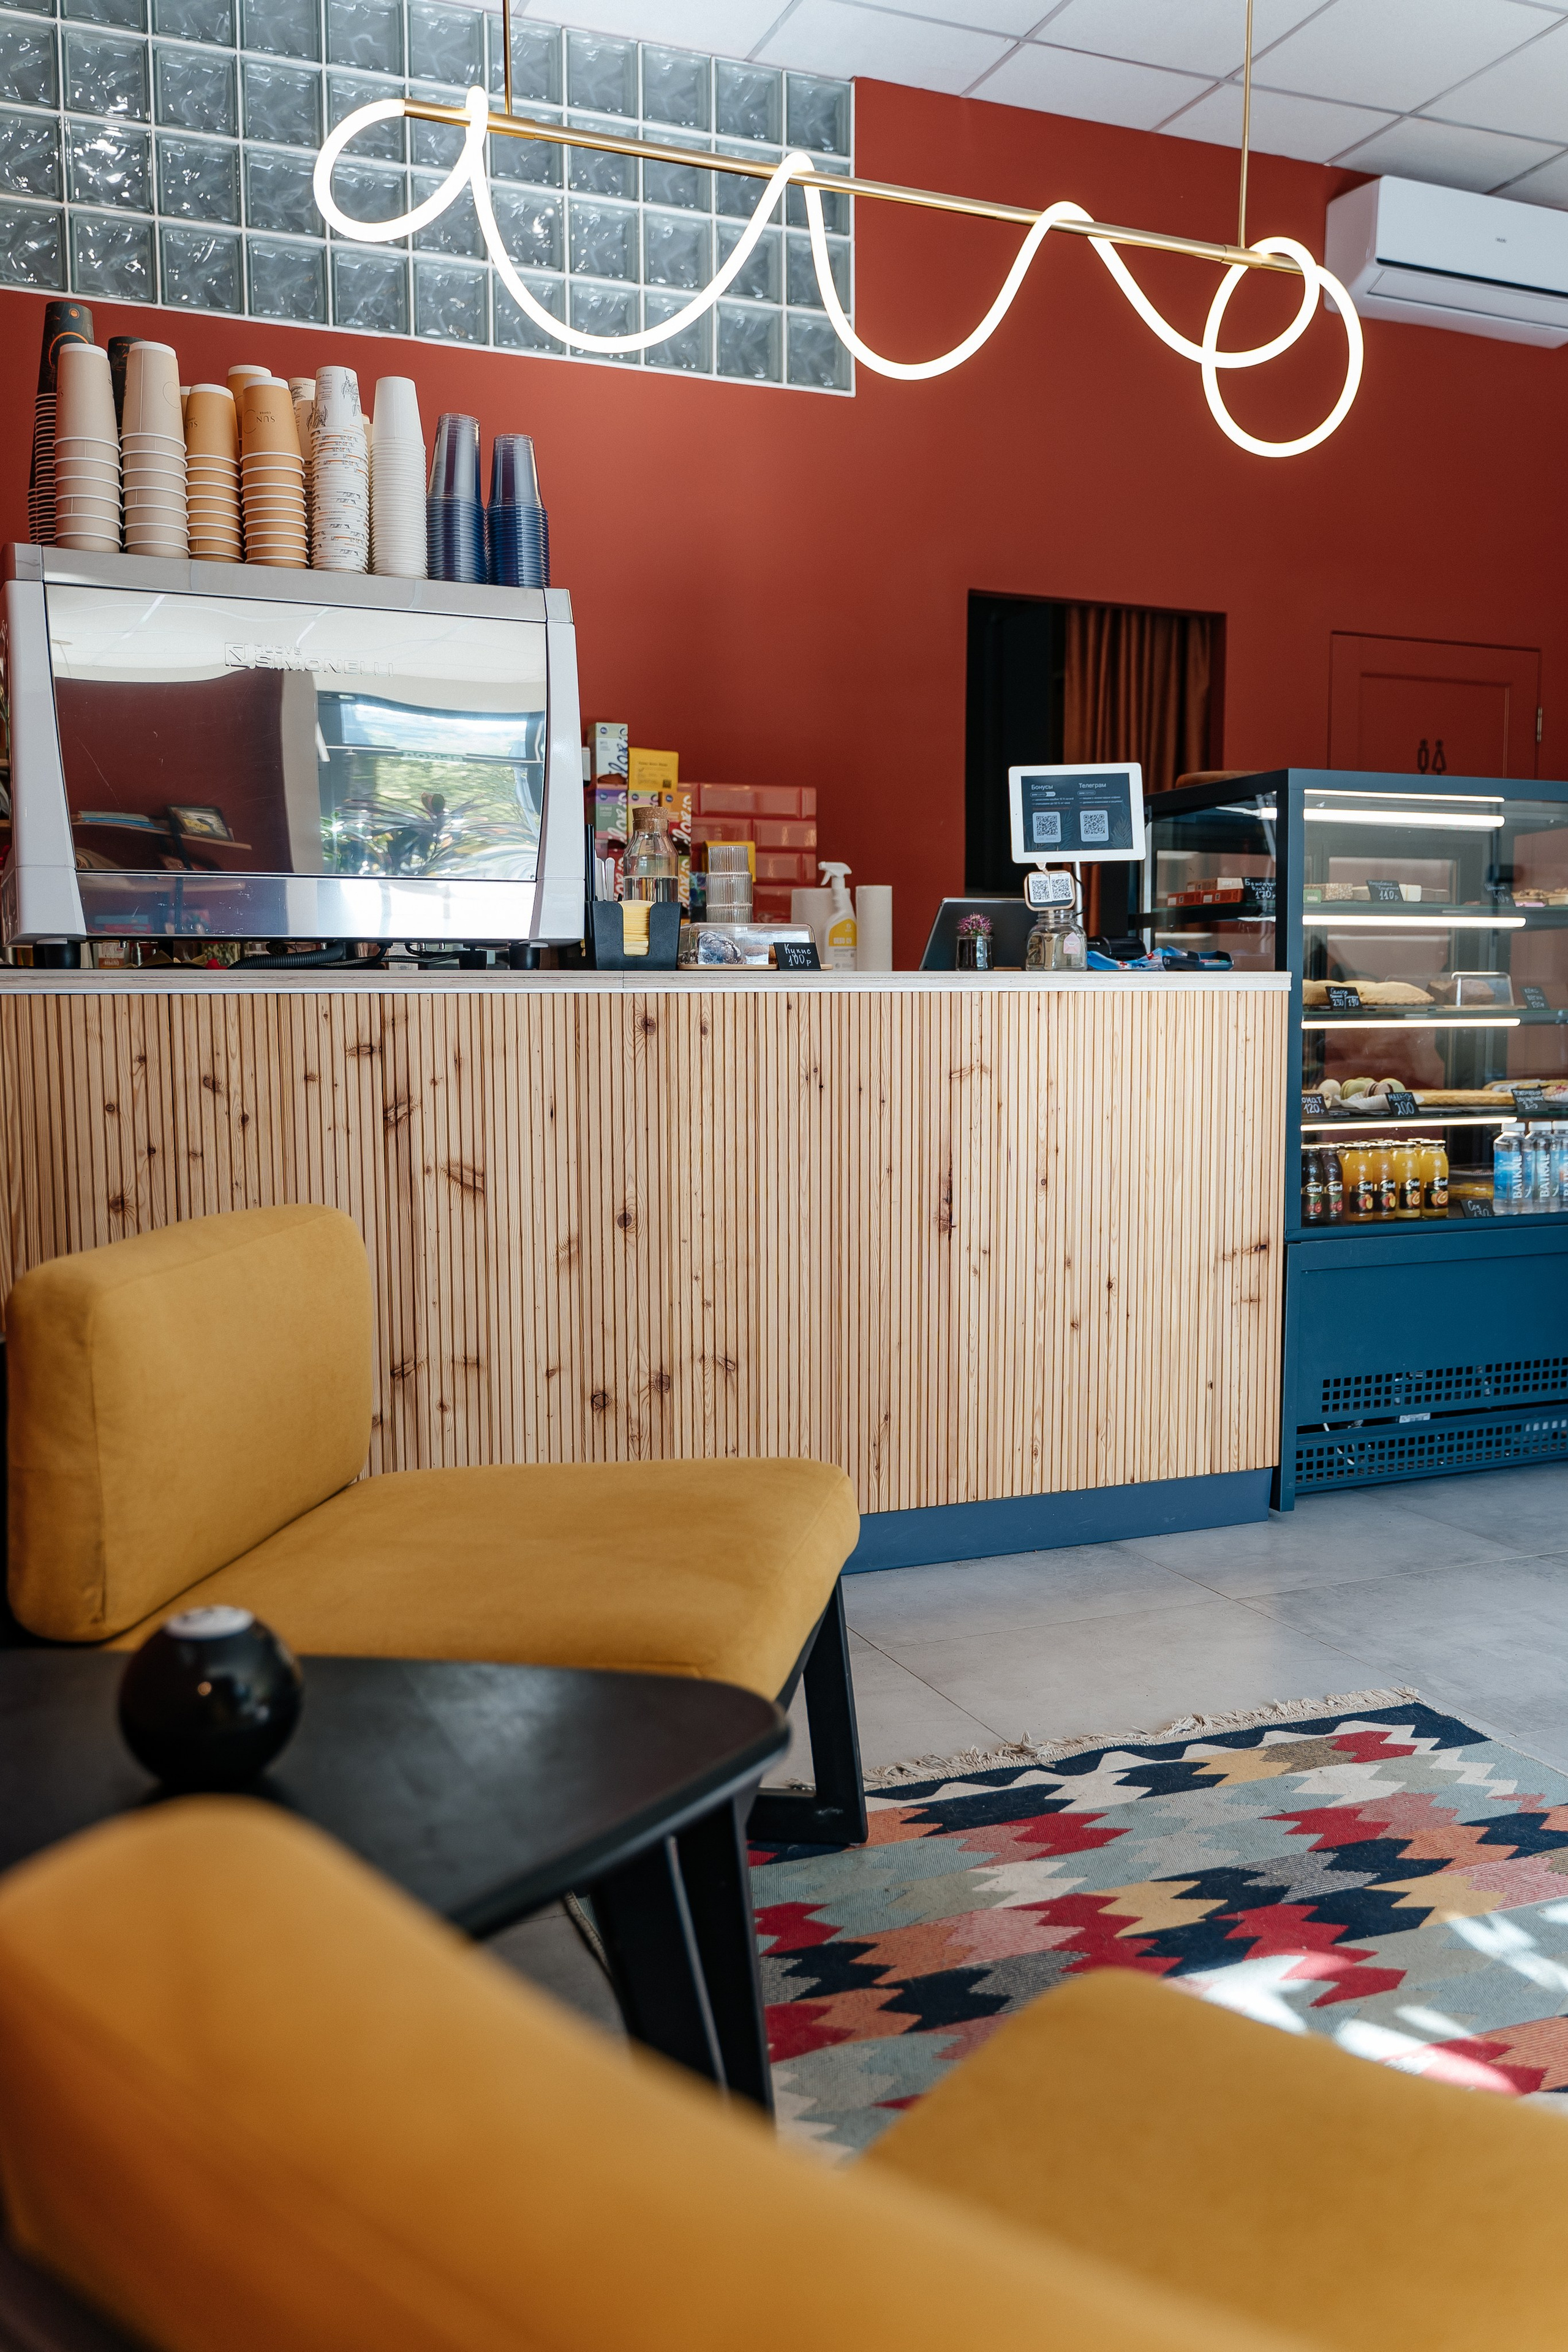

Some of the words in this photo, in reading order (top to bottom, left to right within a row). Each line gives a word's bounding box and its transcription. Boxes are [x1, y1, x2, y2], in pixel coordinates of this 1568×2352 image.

[255, 654, 393, 677] SIMONELLI
[1256, 891, 1272, 899] 170
[1379, 890, 1395, 900] 110
[784, 943, 812, 957] Кукис
[788, 954, 805, 967] 100
[1303, 1103, 1320, 1114] 120
[1395, 1101, 1415, 1115] 200
[1512, 1155, 1523, 1199] BAIKAL
[1539, 1153, 1550, 1197] BAIKAL
